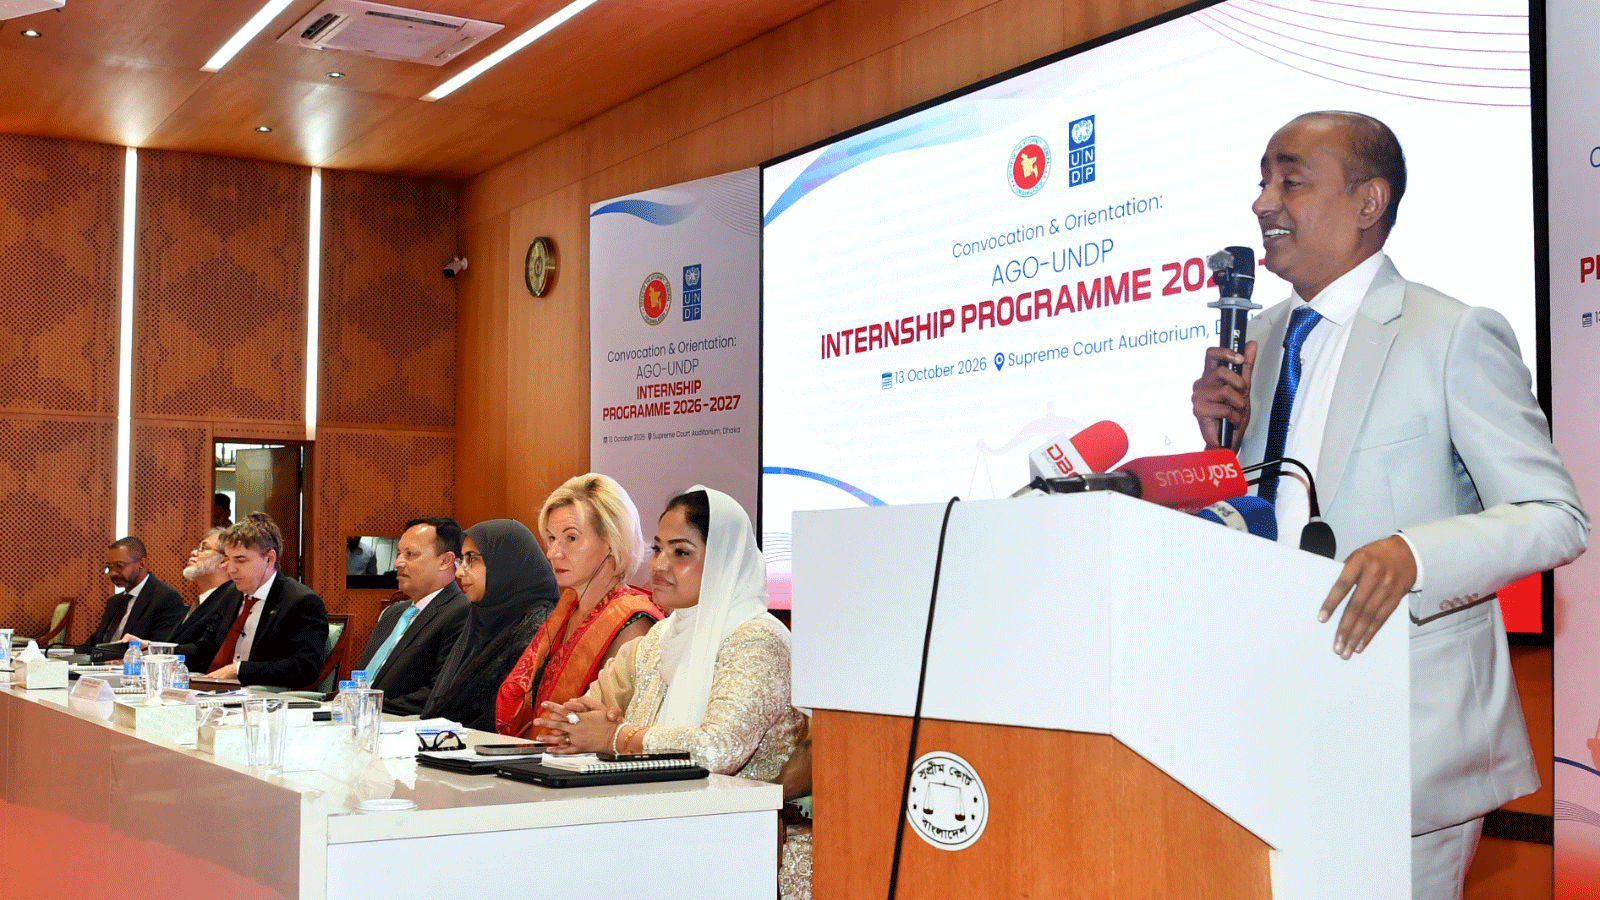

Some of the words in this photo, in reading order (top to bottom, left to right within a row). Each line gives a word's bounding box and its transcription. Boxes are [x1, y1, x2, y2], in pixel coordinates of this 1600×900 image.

[952, 224, 1044, 258] Convocation
[1049, 218, 1060, 235] &
[1064, 195, 1163, 230] Orientation:
[992, 238, 1114, 287] AGO-UNDP
[821, 308, 955, 360] INTERNSHIP
[961, 267, 1151, 333] PROGRAMME
[607, 344, 666, 362] Convocation
[668, 342, 675, 355] &
[678, 336, 737, 354] Orientation:
[894, 370, 905, 384] 13
[907, 364, 954, 382] October
[957, 356, 987, 375] 2026
[1008, 345, 1069, 369] Supreme
[1073, 337, 1114, 356] Court
[1118, 323, 1210, 350] Auditorium,
[636, 358, 699, 380] AGO-UNDP
[636, 379, 702, 400] INTERNSHIP
[602, 401, 671, 421] PROGRAMME
[613, 434, 633, 443] October
[652, 431, 676, 441] Supreme
[676, 430, 691, 439] Court
[722, 425, 741, 435] Dhaka
[921, 815, 968, 840] বাংলাদেশ
